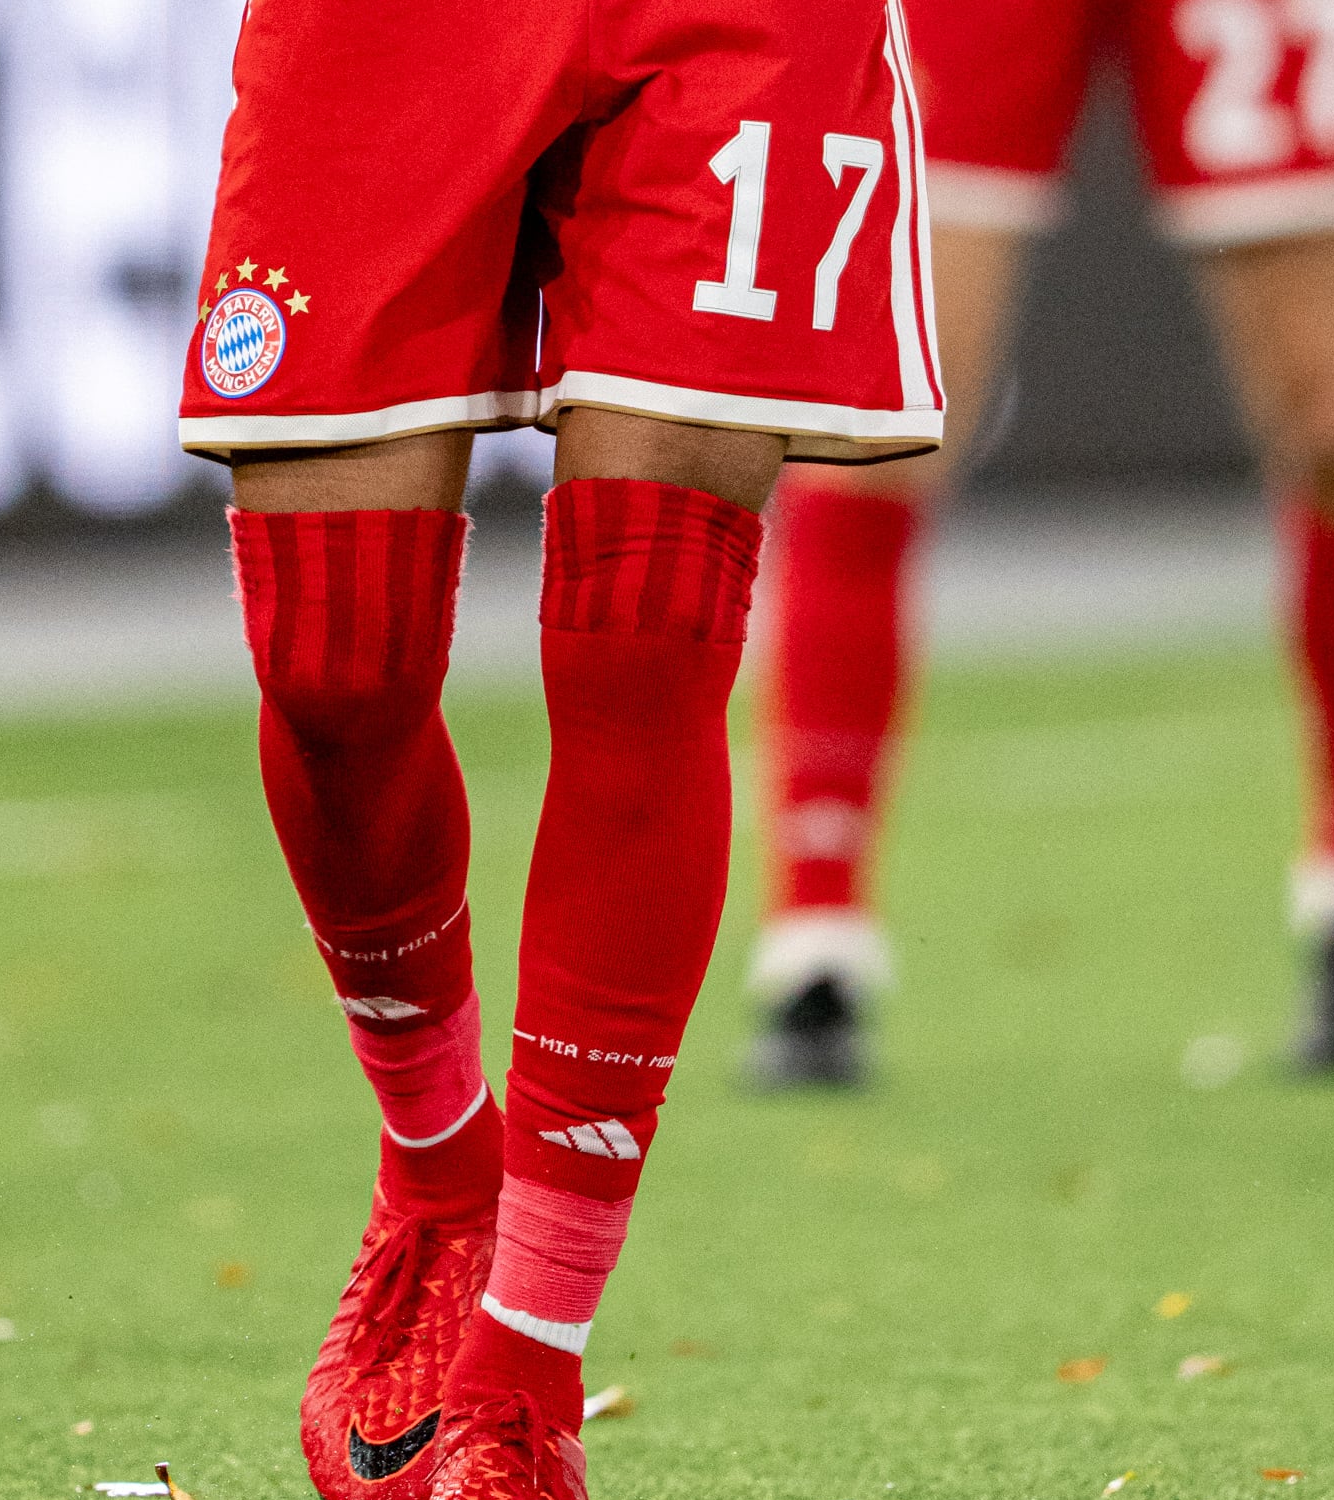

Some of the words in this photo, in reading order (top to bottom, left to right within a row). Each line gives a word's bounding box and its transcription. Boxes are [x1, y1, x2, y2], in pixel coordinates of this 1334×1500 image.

[692, 119, 884, 331] 17
[223, 296, 278, 333] BAYERN
[397, 931, 438, 957] MIA
[539, 1034, 579, 1058] MIA
